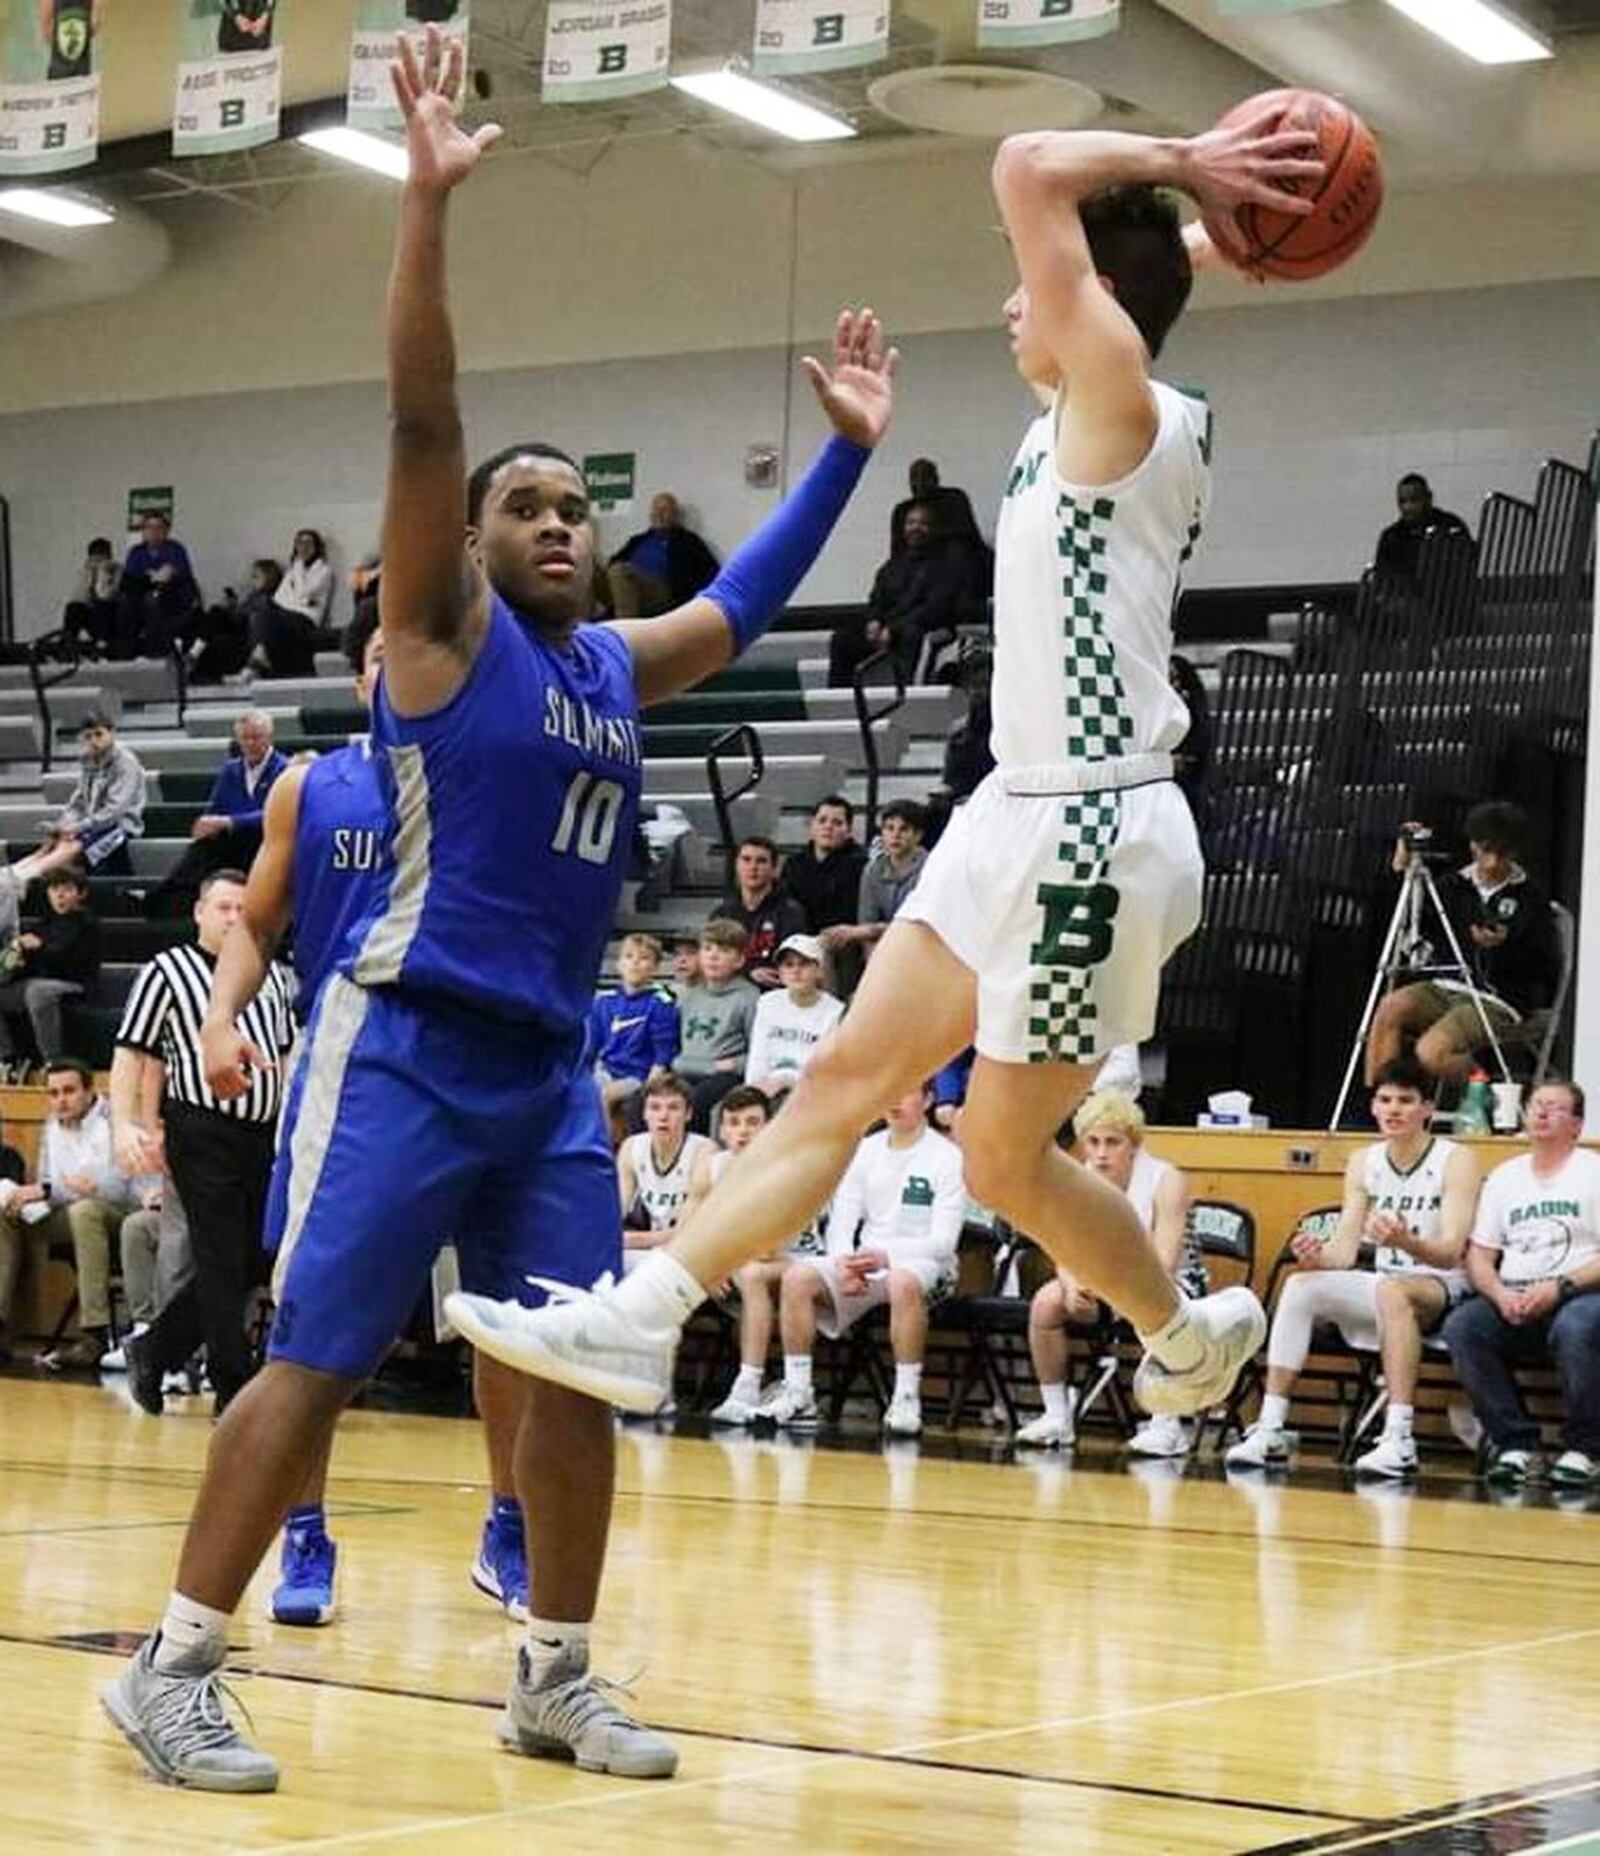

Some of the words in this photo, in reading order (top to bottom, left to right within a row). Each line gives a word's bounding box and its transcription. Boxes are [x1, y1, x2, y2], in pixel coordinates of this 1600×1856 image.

[811, 14, 845, 45] B
[597, 44, 627, 75] B
[219, 99, 245, 128] B
[42, 123, 67, 150] B
[551, 770, 625, 866] 10
[1029, 882, 1120, 969] B
[1509, 1200, 1580, 1227] BADIN
